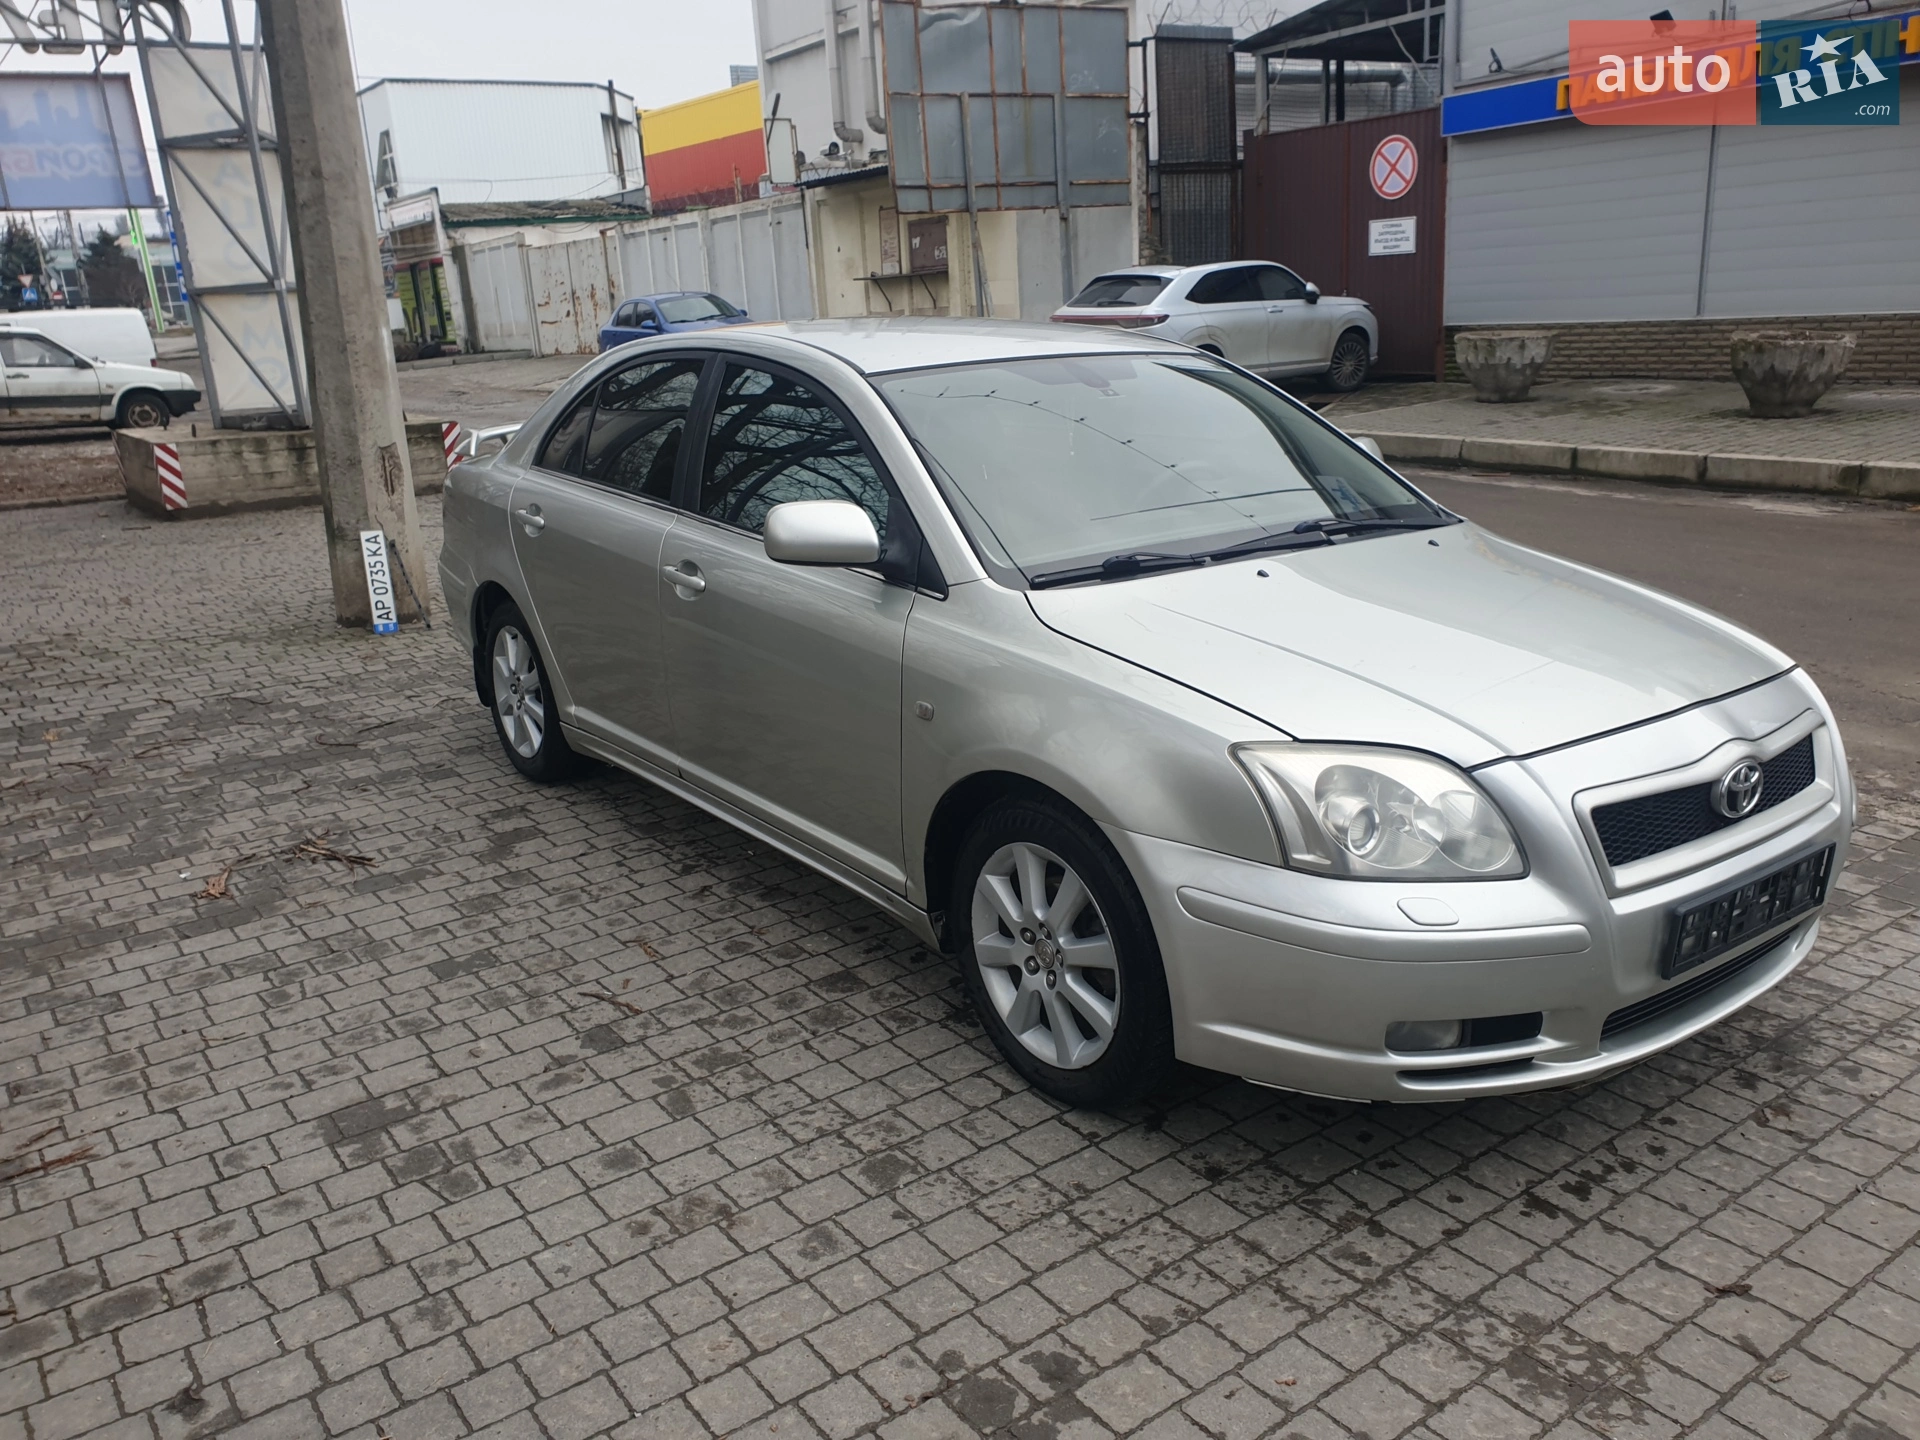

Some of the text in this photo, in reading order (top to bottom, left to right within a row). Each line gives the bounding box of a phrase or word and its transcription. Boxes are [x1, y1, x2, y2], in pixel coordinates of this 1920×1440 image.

[364, 534, 394, 621] AP 0735 KA
